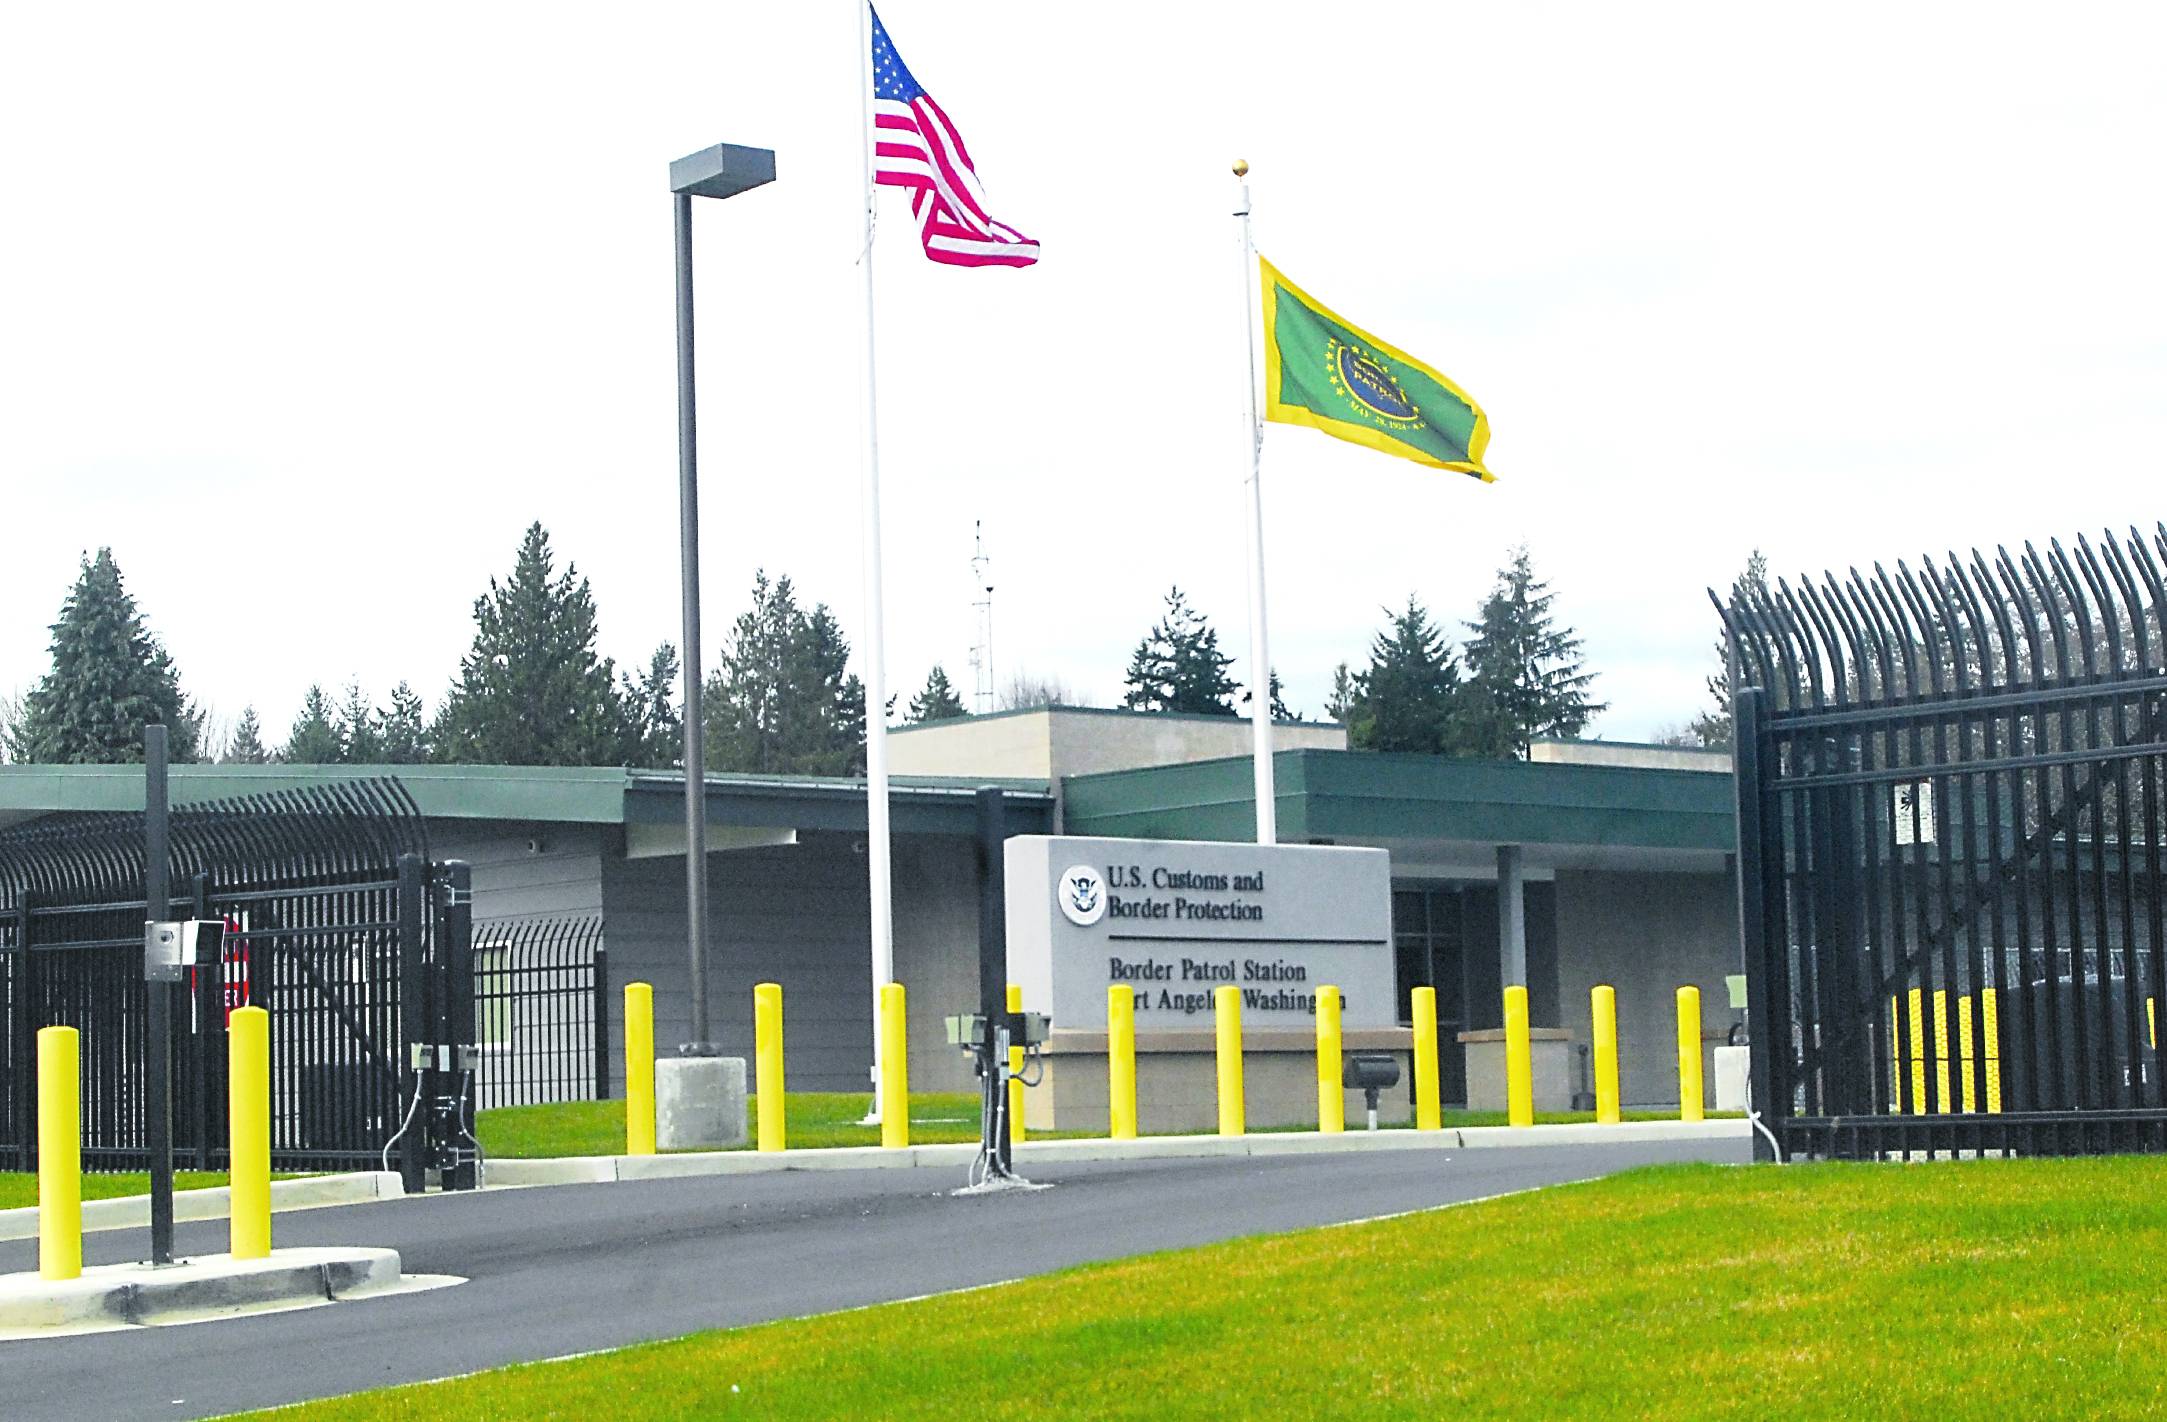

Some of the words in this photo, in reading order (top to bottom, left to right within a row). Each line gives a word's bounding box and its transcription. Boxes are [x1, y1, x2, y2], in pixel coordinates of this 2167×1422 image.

[1107, 865, 1147, 888] U.S.
[1152, 867, 1228, 890] Customs
[1233, 870, 1263, 891] and
[1107, 895, 1170, 918] Border
[1175, 897, 1263, 920] Protection
[1109, 957, 1173, 980] Border
[1181, 958, 1236, 981] Patrol
[1244, 959, 1307, 982] Station
[1158, 988, 1216, 1014] Angel
[1242, 988, 1346, 1015] Washingn
